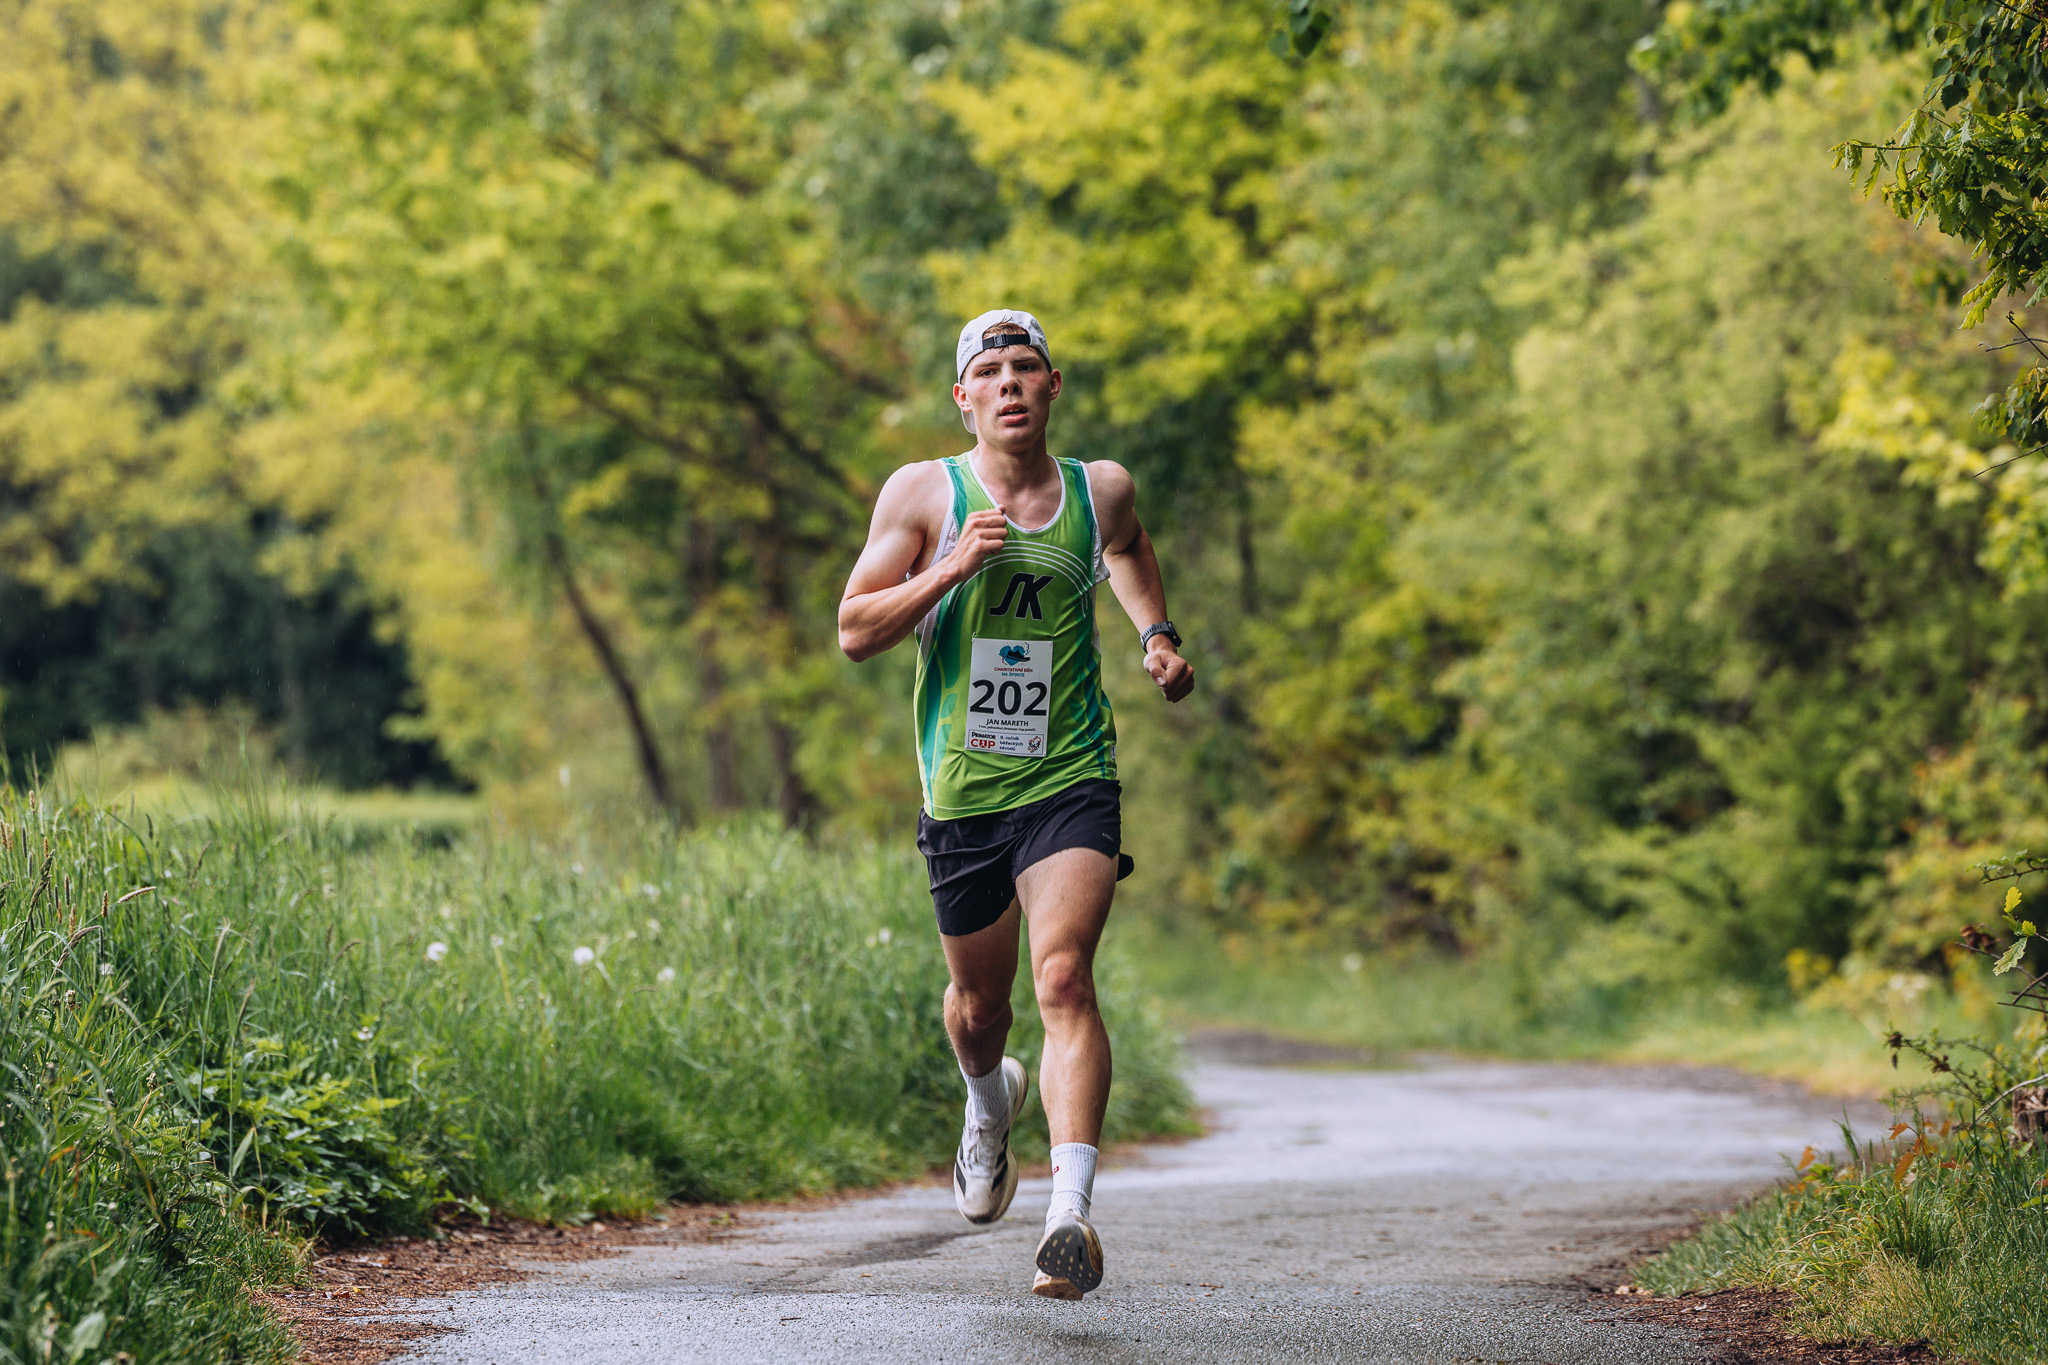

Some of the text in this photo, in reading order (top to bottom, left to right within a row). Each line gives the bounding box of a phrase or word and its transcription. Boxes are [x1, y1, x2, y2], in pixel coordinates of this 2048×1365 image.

[969, 679, 1048, 716] 202
[986, 718, 1029, 727] JAN MARETH
[971, 739, 996, 748] CUP
